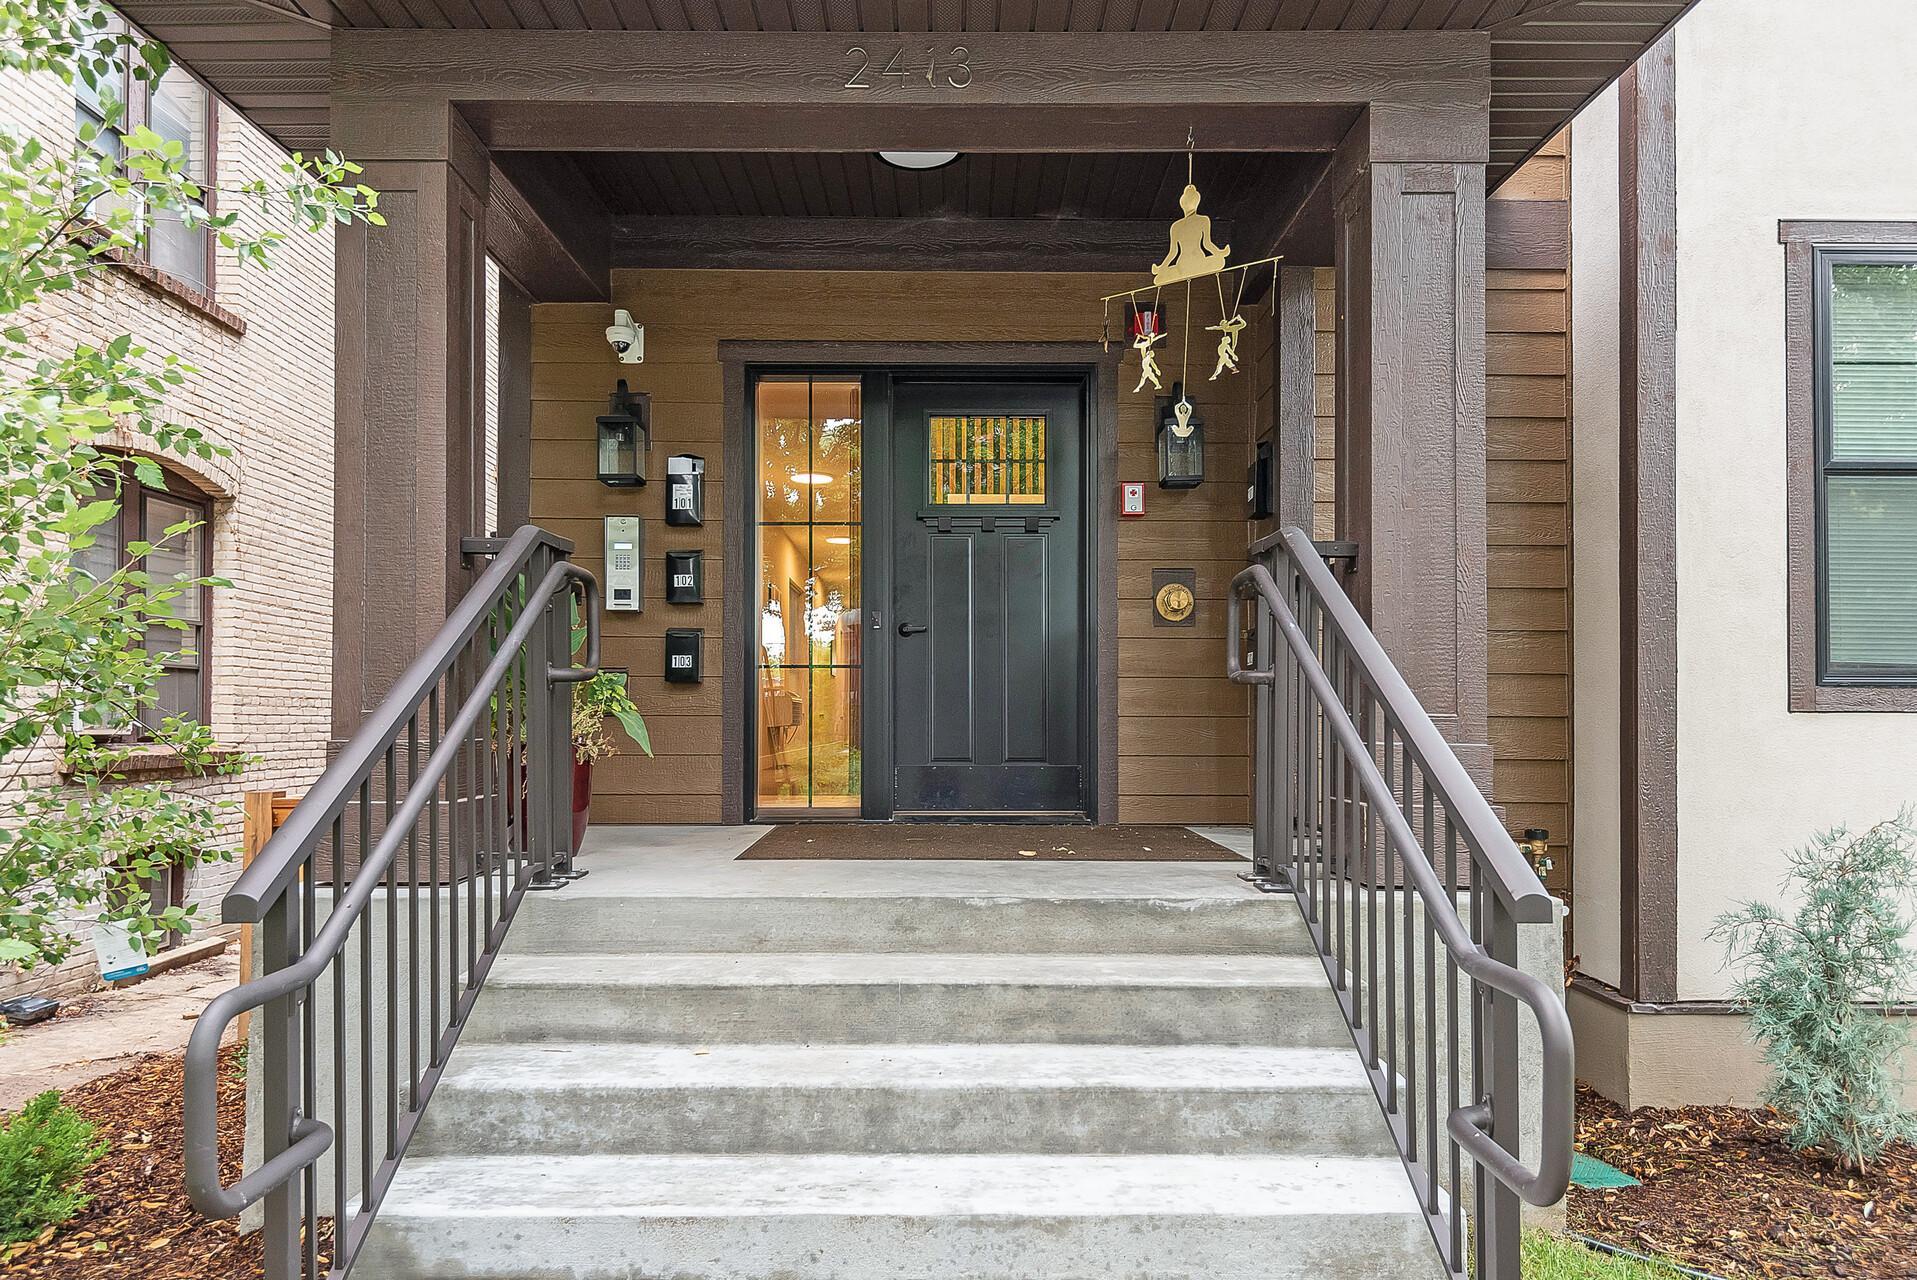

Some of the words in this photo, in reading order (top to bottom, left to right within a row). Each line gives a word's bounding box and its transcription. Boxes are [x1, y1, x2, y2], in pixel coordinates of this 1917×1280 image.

[844, 46, 973, 88] 2413
[674, 498, 692, 509] 101
[675, 575, 693, 586] 102
[673, 656, 691, 667] 103
